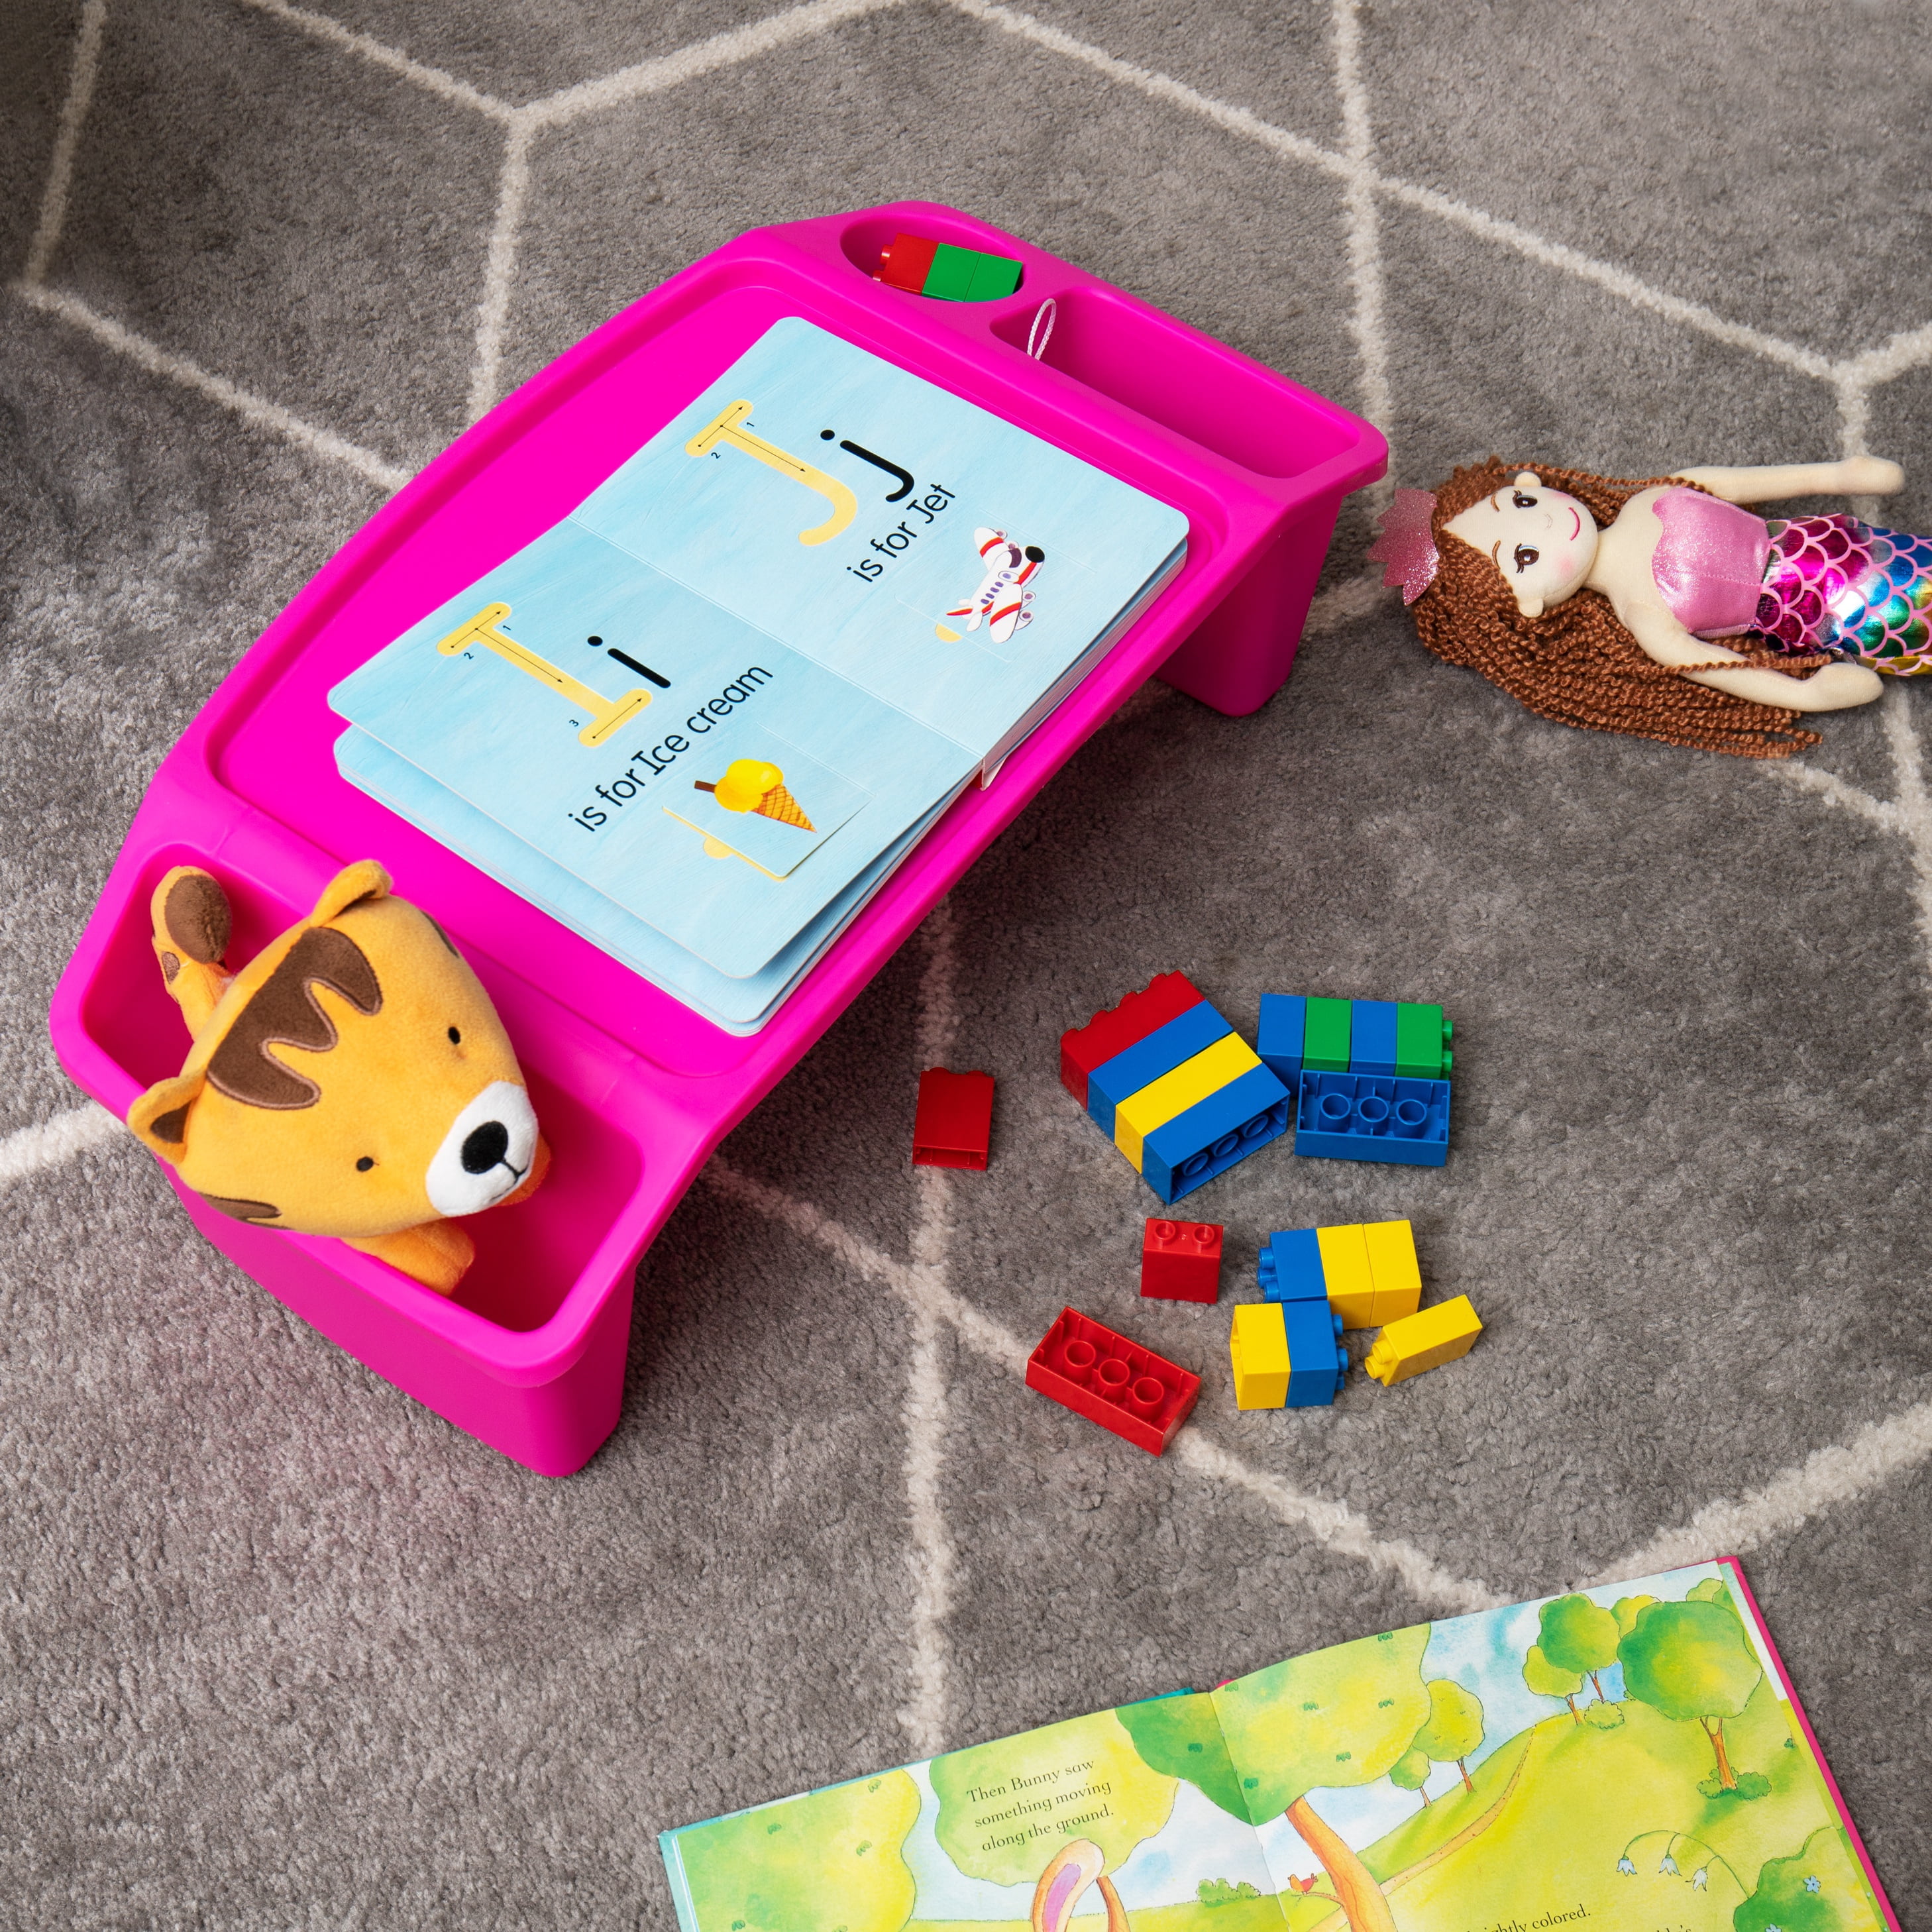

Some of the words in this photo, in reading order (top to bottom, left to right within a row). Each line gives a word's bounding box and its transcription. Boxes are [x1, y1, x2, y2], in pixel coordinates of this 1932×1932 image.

[685, 399, 858, 546] J
[820, 429, 915, 503] j
[710, 451, 721, 460] 2
[846, 559, 884, 582] is
[869, 521, 918, 559] for
[906, 483, 956, 524] Jet
[437, 602, 653, 748] I
[587, 635, 672, 689] i
[463, 652, 474, 661] 2
[569, 719, 579, 727] 3
[567, 806, 608, 832] is
[595, 767, 645, 807] for
[631, 735, 690, 777] Ice
[686, 666, 774, 734] cream
[966, 1786, 1006, 1803] Then
[1010, 1769, 1060, 1791] Bunny
[1065, 1760, 1095, 1776] saw
[975, 1799, 1053, 1828] something
[1055, 1781, 1112, 1804] moving
[981, 1832, 1026, 1852] along
[1028, 1823, 1051, 1839] the
[1055, 1803, 1114, 1835] ground.
[1532, 1903, 1591, 1930] colored.
